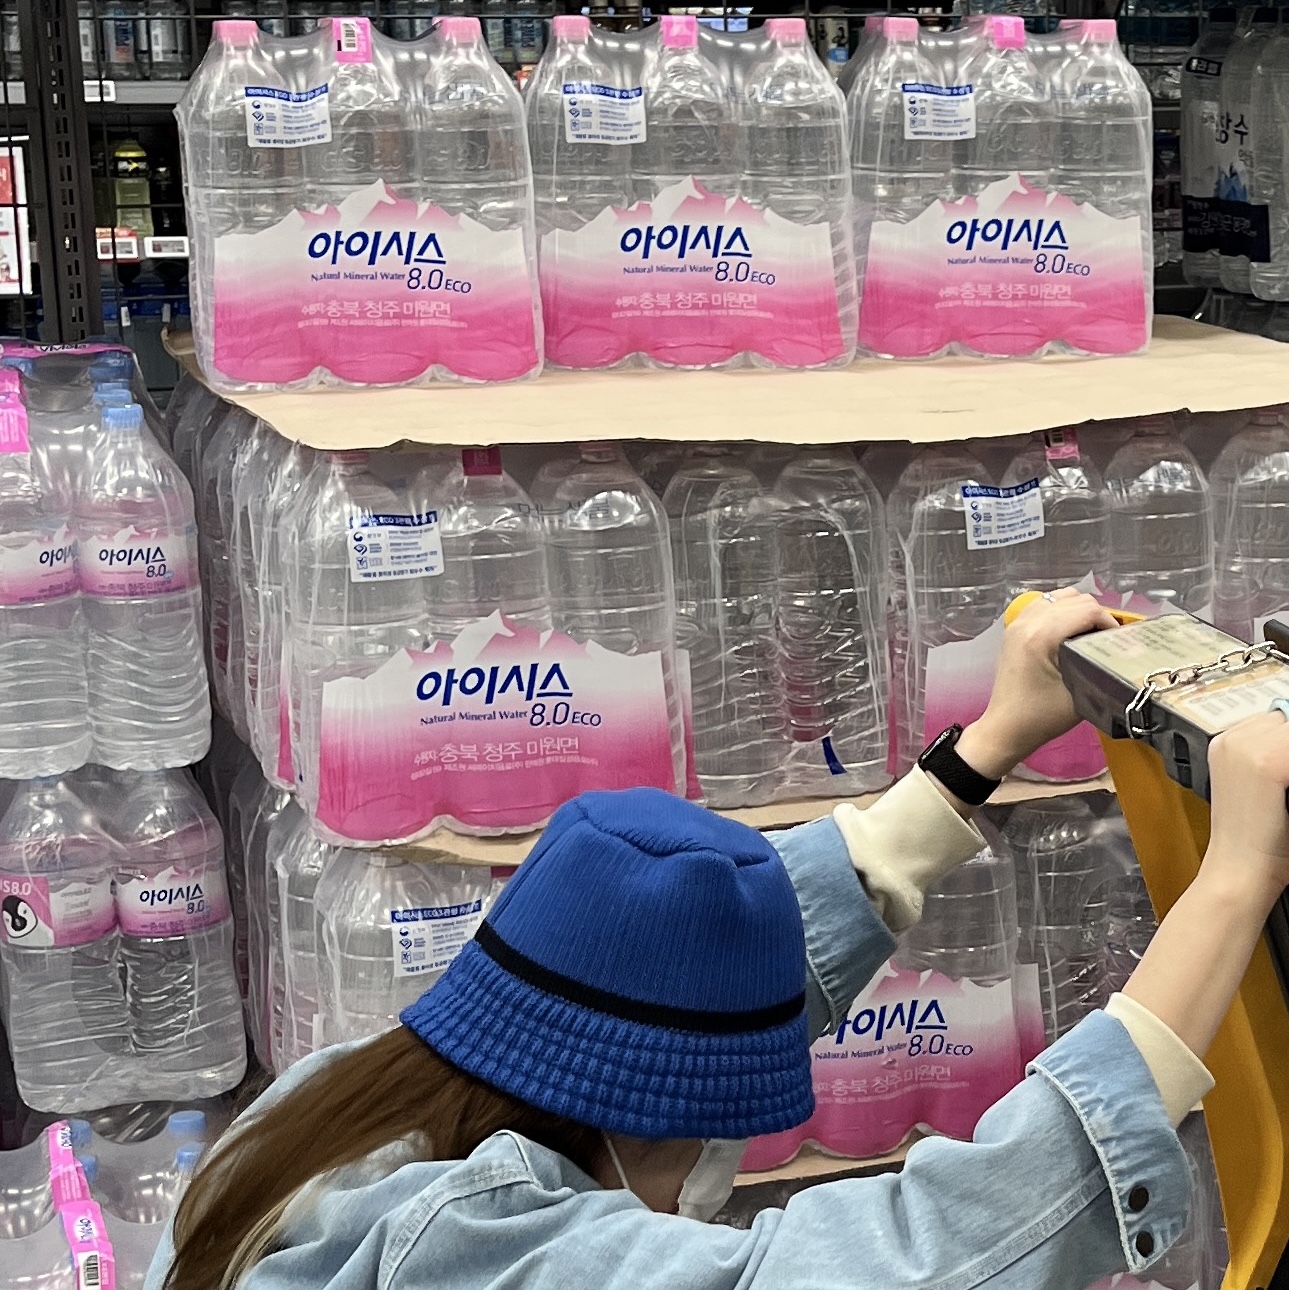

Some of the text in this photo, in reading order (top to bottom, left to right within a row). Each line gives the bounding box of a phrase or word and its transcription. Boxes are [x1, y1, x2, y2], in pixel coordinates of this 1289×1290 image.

[620, 225, 752, 259] 아이시스
[946, 218, 1069, 250] 아이시스
[308, 230, 447, 265] 아이시스
[623, 265, 653, 274] Natural
[656, 264, 687, 273] Mineral
[715, 261, 750, 282] 8.0
[751, 271, 776, 285] ECO
[1034, 253, 1065, 274] 8.0
[1066, 262, 1090, 276] ECO
[407, 267, 443, 290] 8.0
[445, 279, 472, 293] ECO
[326, 300, 359, 318] 충북
[364, 300, 400, 318] 청주
[403, 300, 450, 318] 미원면
[99, 546, 166, 565] 아이시스
[146, 564, 166, 577] 8.0
[416, 662, 573, 706] 아이시스
[420, 702, 602, 727] Natural Mineral Water 8.0 ECO
[439, 742, 479, 763] 충북
[482, 742, 524, 763] 청주
[526, 736, 580, 757] 미원면
[139, 884, 204, 906] 아이시스
[186, 900, 205, 914] 8.0
[908, 1034, 944, 1057] 8.0
[945, 1043, 974, 1056] ECO
